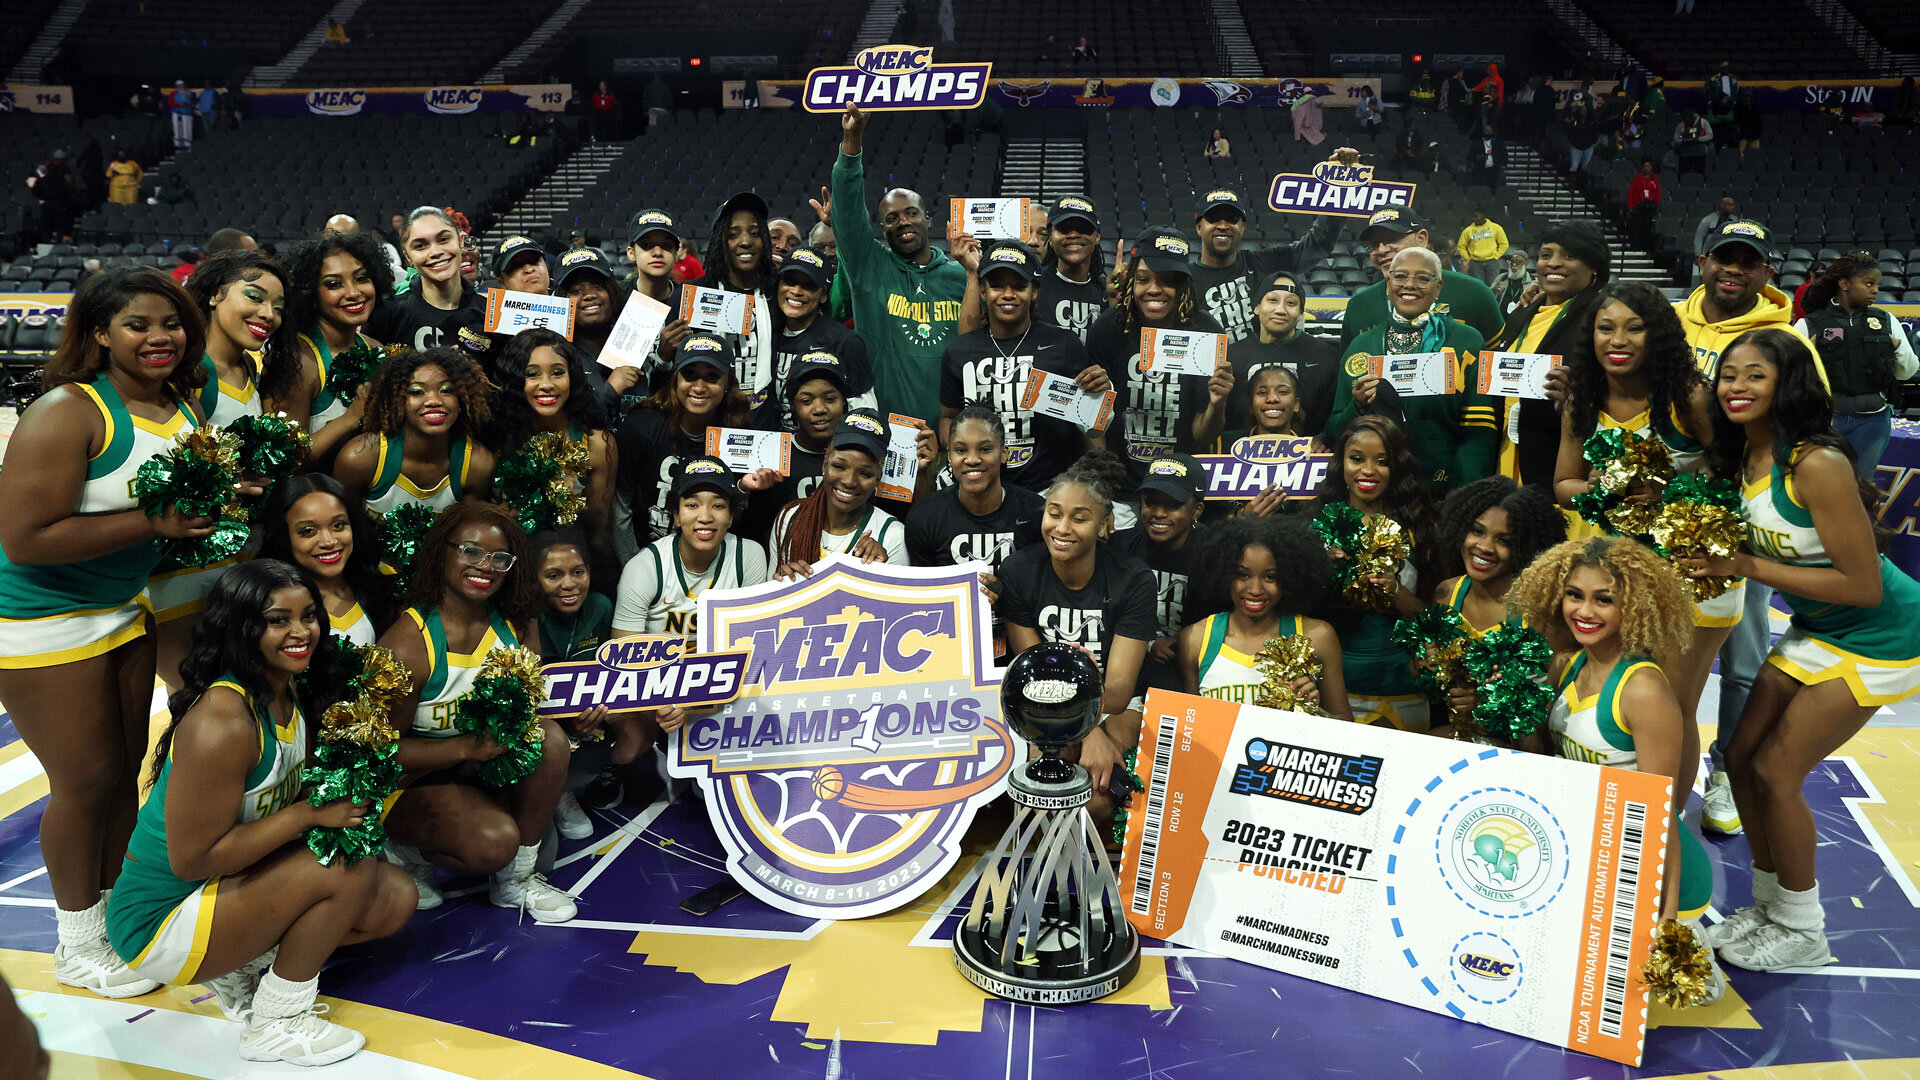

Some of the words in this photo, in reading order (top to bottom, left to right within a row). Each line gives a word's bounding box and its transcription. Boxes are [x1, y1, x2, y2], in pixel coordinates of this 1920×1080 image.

[863, 49, 931, 72] MEAC
[313, 90, 365, 107] MEAC
[431, 88, 482, 107] MEAC
[541, 93, 562, 103] 113
[730, 89, 745, 99] 11
[809, 71, 981, 104] CHAMPS
[1347, 87, 1361, 98] 11
[1850, 86, 1875, 103] IN
[1320, 164, 1371, 183] MEAC
[1275, 180, 1408, 211] CHAMPS
[1205, 275, 1250, 309] CUT
[1055, 299, 1101, 328] CUT
[1209, 297, 1255, 329] THE
[976, 355, 1034, 385] CUT
[1126, 380, 1181, 412] THE
[1000, 410, 1035, 439] ET
[1124, 410, 1180, 437] NET
[1241, 438, 1310, 460] MEAC
[1201, 462, 1329, 491] HAMP
[950, 532, 1015, 566] CUT
[1152, 569, 1189, 604] UT
[1038, 605, 1104, 642] CUT
[607, 637, 685, 667] MEAC
[742, 610, 944, 695] MEAC
[543, 660, 738, 708] CHAMPS
[1027, 682, 1078, 699] MEAC
[722, 685, 958, 714] BASKETBALL
[1185, 708, 1196, 723] 23
[1181, 724, 1194, 752] SEAT
[1250, 748, 1267, 758] NCAA
[1266, 745, 1343, 778] MARCH
[1027, 788, 1092, 808] BASKETBALL
[1173, 791, 1184, 807] 12
[1272, 770, 1375, 808] MADNESS
[1169, 808, 1182, 833] ROW
[1600, 781, 1619, 848] QUALIFIER
[1222, 819, 1286, 859] 2023
[1292, 832, 1373, 872] TICKET
[1454, 804, 1487, 843] NORFOLK
[1489, 804, 1518, 817] STATE
[1520, 812, 1551, 864] UNIVERSITY
[755, 863, 819, 899] MARCH
[876, 860, 921, 895] 2023
[1162, 871, 1172, 880] 3
[1237, 848, 1347, 895] PUNCHED
[1596, 849, 1612, 923] AUTOMATIC
[1473, 883, 1515, 900] SPARTANS
[1155, 884, 1171, 930] SECTION
[1235, 914, 1330, 947] #MARCHMADNESS
[1220, 930, 1341, 970] @MARCHMADNESSWBB
[1463, 953, 1516, 977] MEAC
[1583, 923, 1602, 1014] TOURNAMENT
[957, 960, 1036, 1001] TOURNAMENT
[1577, 1015, 1590, 1044] NCAA
